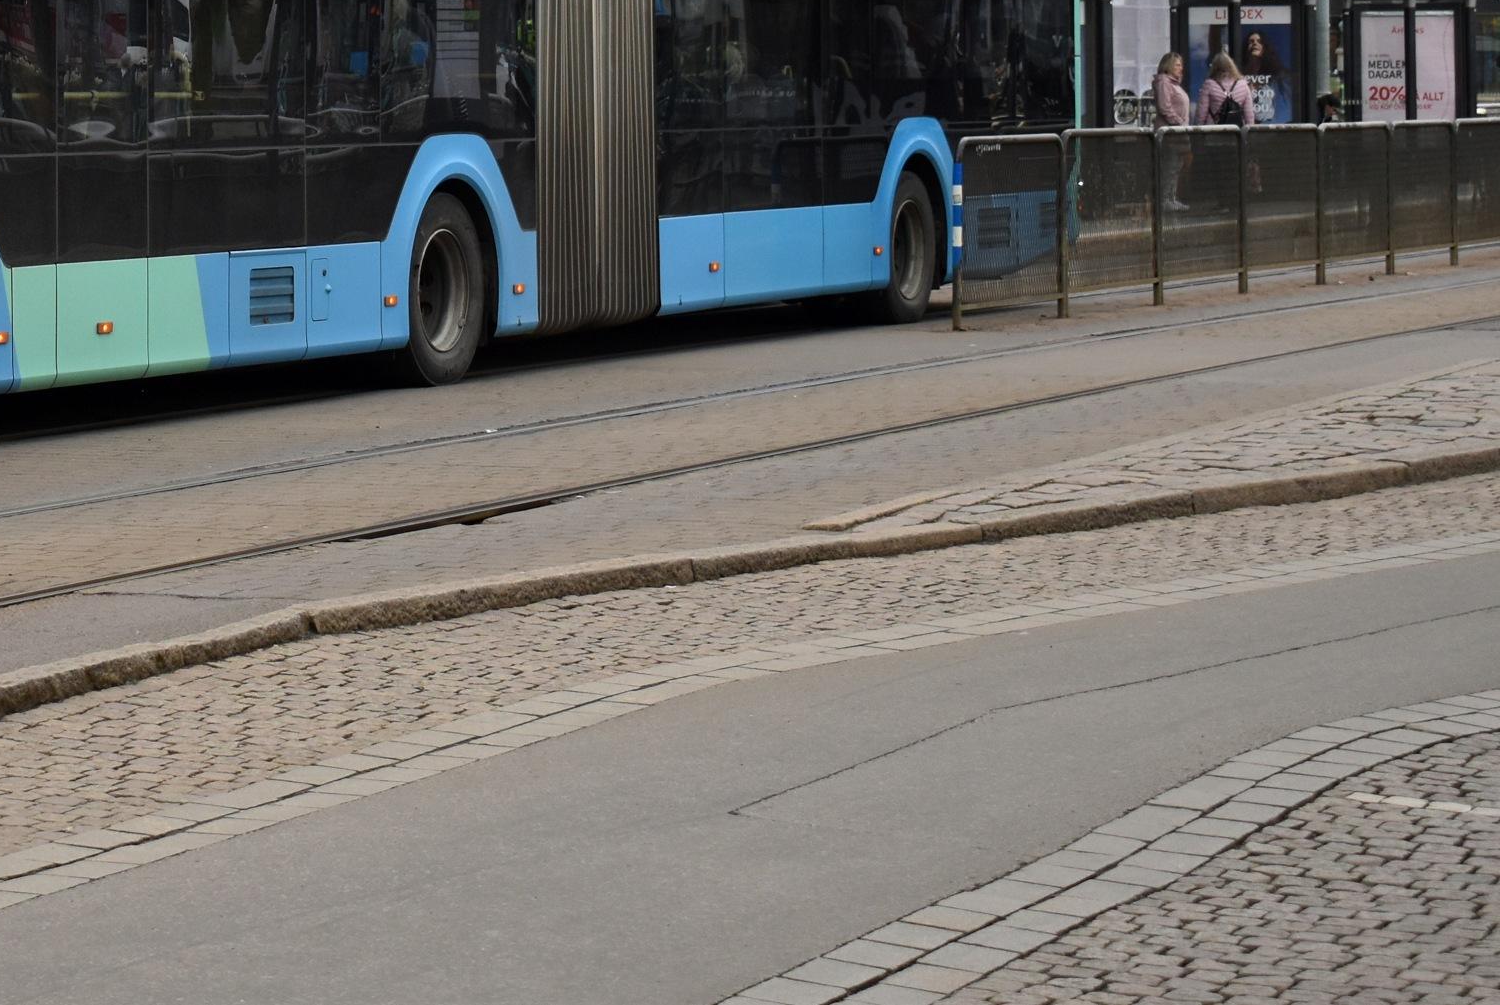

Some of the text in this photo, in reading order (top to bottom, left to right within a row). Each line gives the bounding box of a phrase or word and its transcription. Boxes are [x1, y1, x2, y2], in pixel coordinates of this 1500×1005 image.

[1215, 9, 1264, 20] LIDEX
[1368, 70, 1402, 79] DAGAR
[1368, 86, 1406, 101] 20%
[1423, 92, 1444, 101] ALLT
